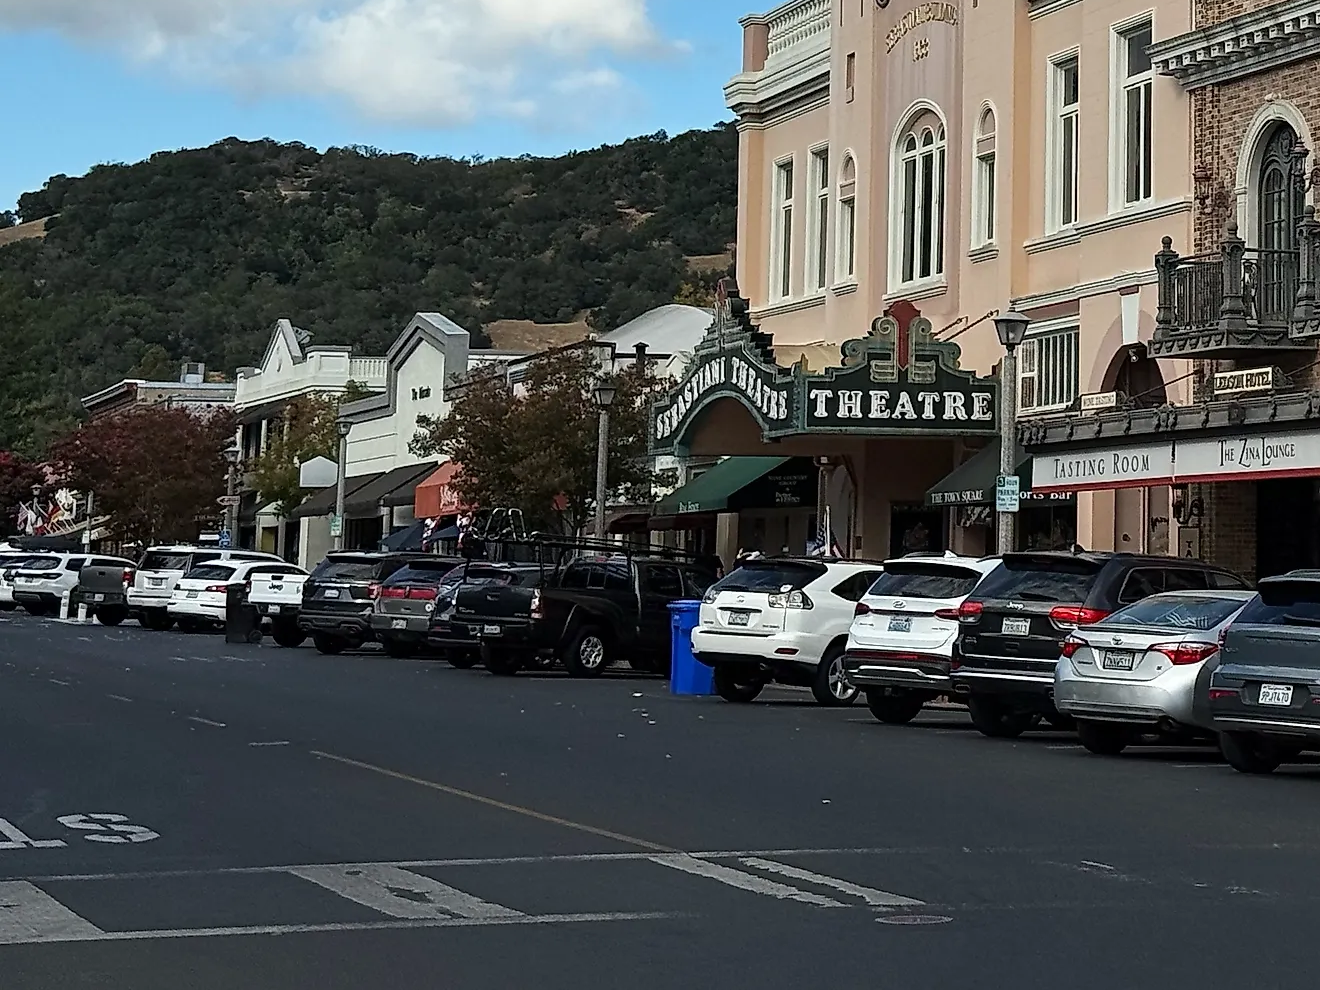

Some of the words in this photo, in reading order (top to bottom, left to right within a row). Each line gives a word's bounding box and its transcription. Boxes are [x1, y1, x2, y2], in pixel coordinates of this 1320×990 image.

[1244, 370, 1272, 388] HOTEL
[656, 356, 726, 440] SEBASTIANI
[731, 356, 788, 420] THEATRE
[810, 389, 993, 421] THEATRE
[1054, 458, 1106, 479] TASTING
[1112, 453, 1150, 475] ROOM
[998, 477, 1005, 486] 3
[931, 492, 943, 504] THE
[944, 491, 961, 503] TOWN
[961, 489, 984, 503] SQUARE
[1020, 492, 1045, 500] orts
[268, 582, 284, 591] Jeep
[1006, 601, 1024, 610] Jeep
